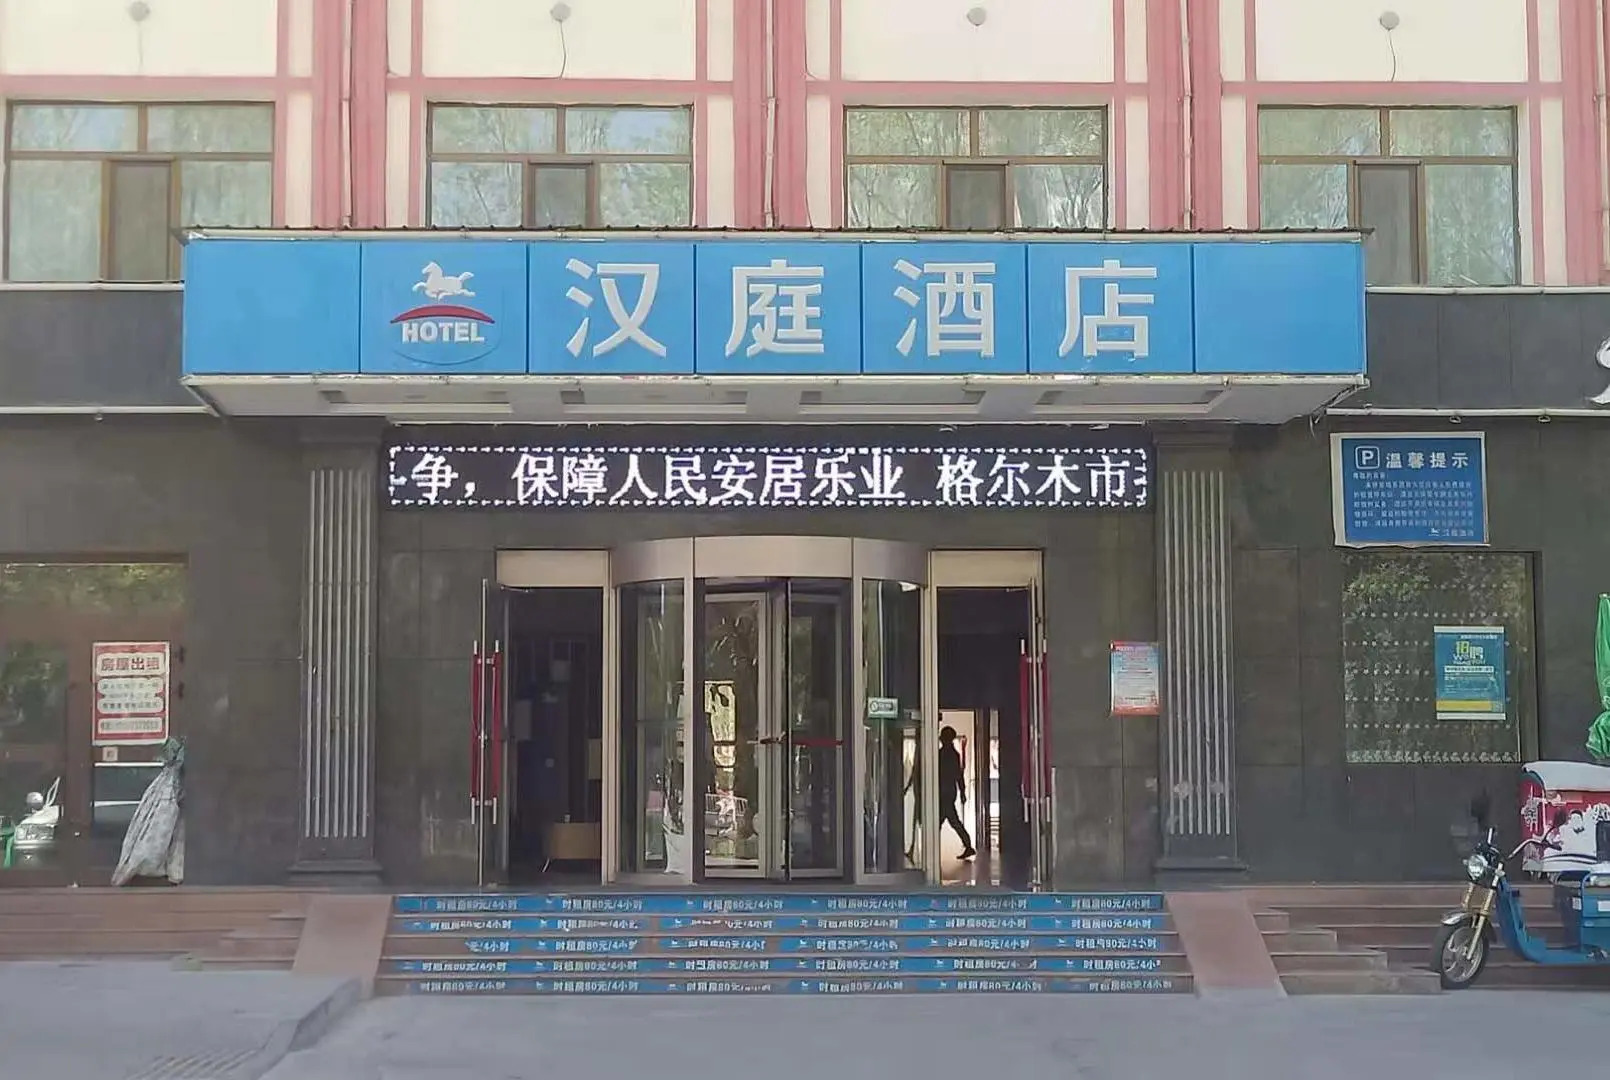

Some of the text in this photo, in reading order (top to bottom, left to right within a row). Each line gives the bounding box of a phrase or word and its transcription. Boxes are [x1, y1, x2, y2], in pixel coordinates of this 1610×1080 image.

[566, 258, 1158, 358] 汉庭酒店
[402, 321, 485, 344] HOTEL
[936, 453, 1130, 502] 格尔木市
[1386, 452, 1469, 469] 温馨提示
